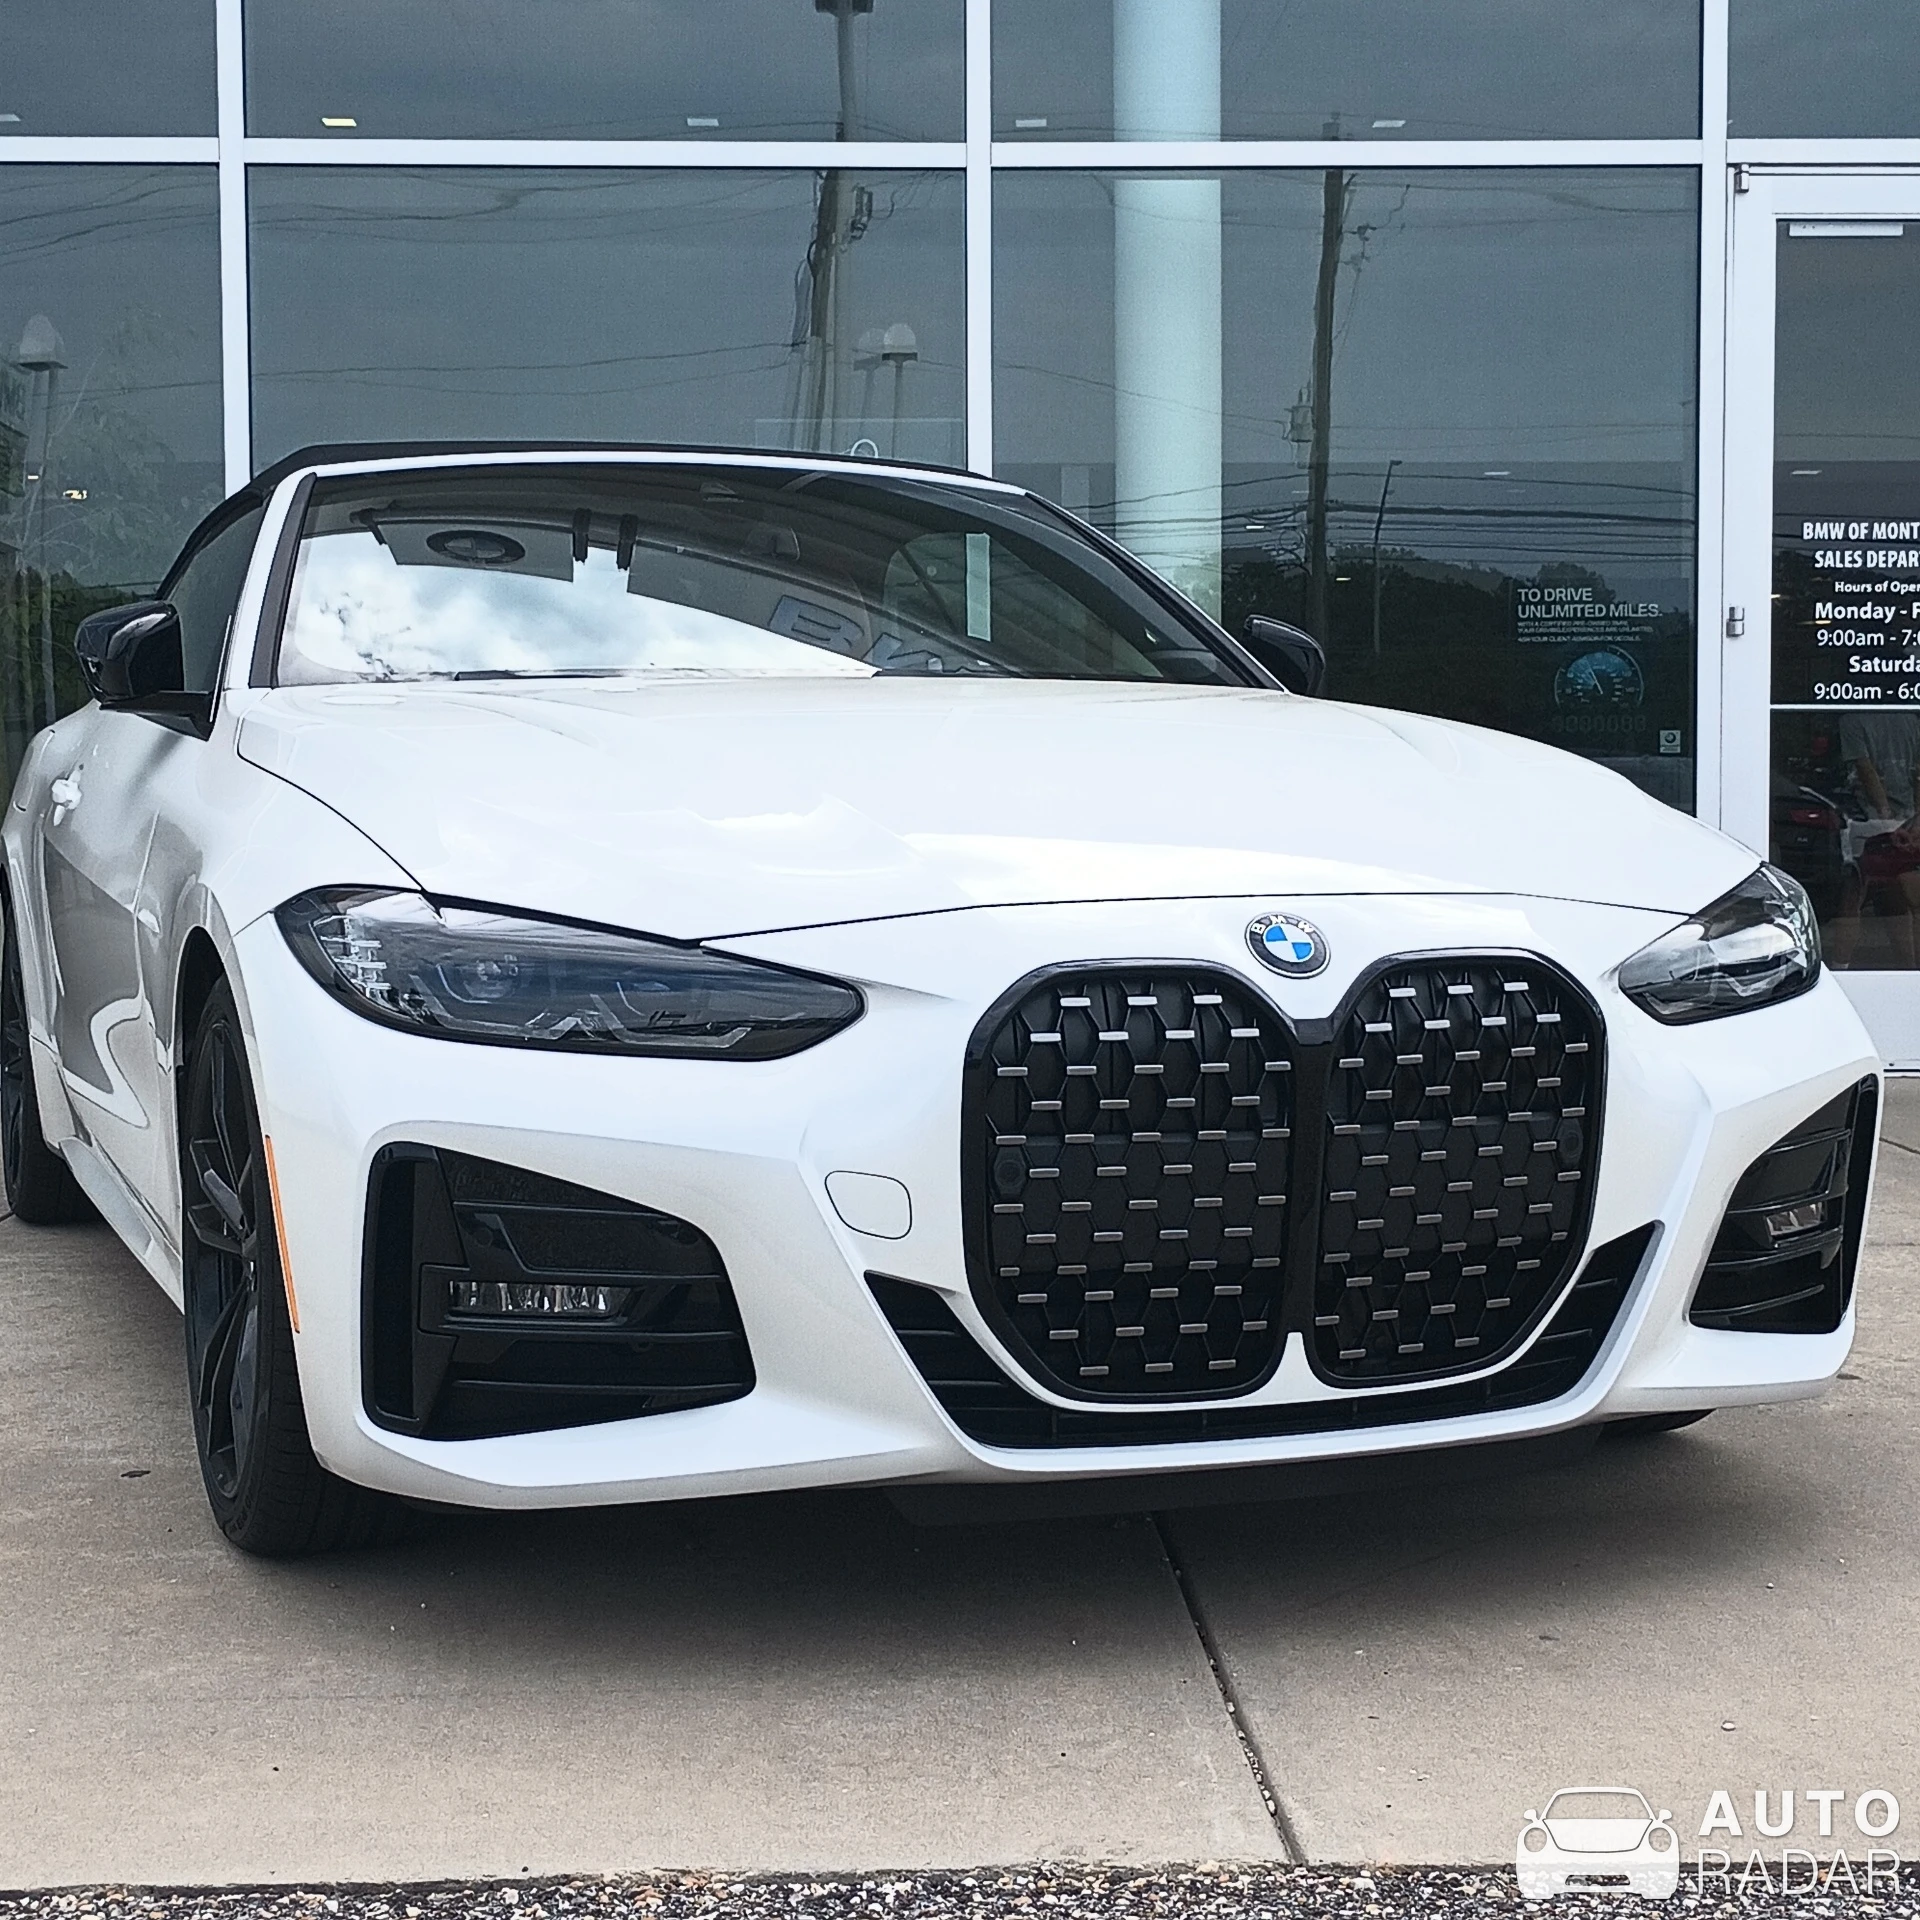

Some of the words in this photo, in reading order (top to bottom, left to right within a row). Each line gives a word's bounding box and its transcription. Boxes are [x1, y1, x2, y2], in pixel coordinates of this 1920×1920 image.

[1803, 522, 1845, 540] BMW
[1848, 522, 1869, 540] OF
[1814, 550, 1863, 568] SALES
[1866, 550, 1920, 568] DEPAR
[1517, 588, 1541, 602] TO
[1544, 588, 1593, 602] DRIVE
[1834, 581, 1872, 593] Hours
[1874, 580, 1889, 593] of
[1517, 604, 1607, 618] UNLIMITED
[1609, 603, 1663, 617] MILES.
[1815, 602, 1896, 624] Monday
[1817, 629, 1884, 646] 9:00am
[1814, 683, 1881, 700] 9:00am
